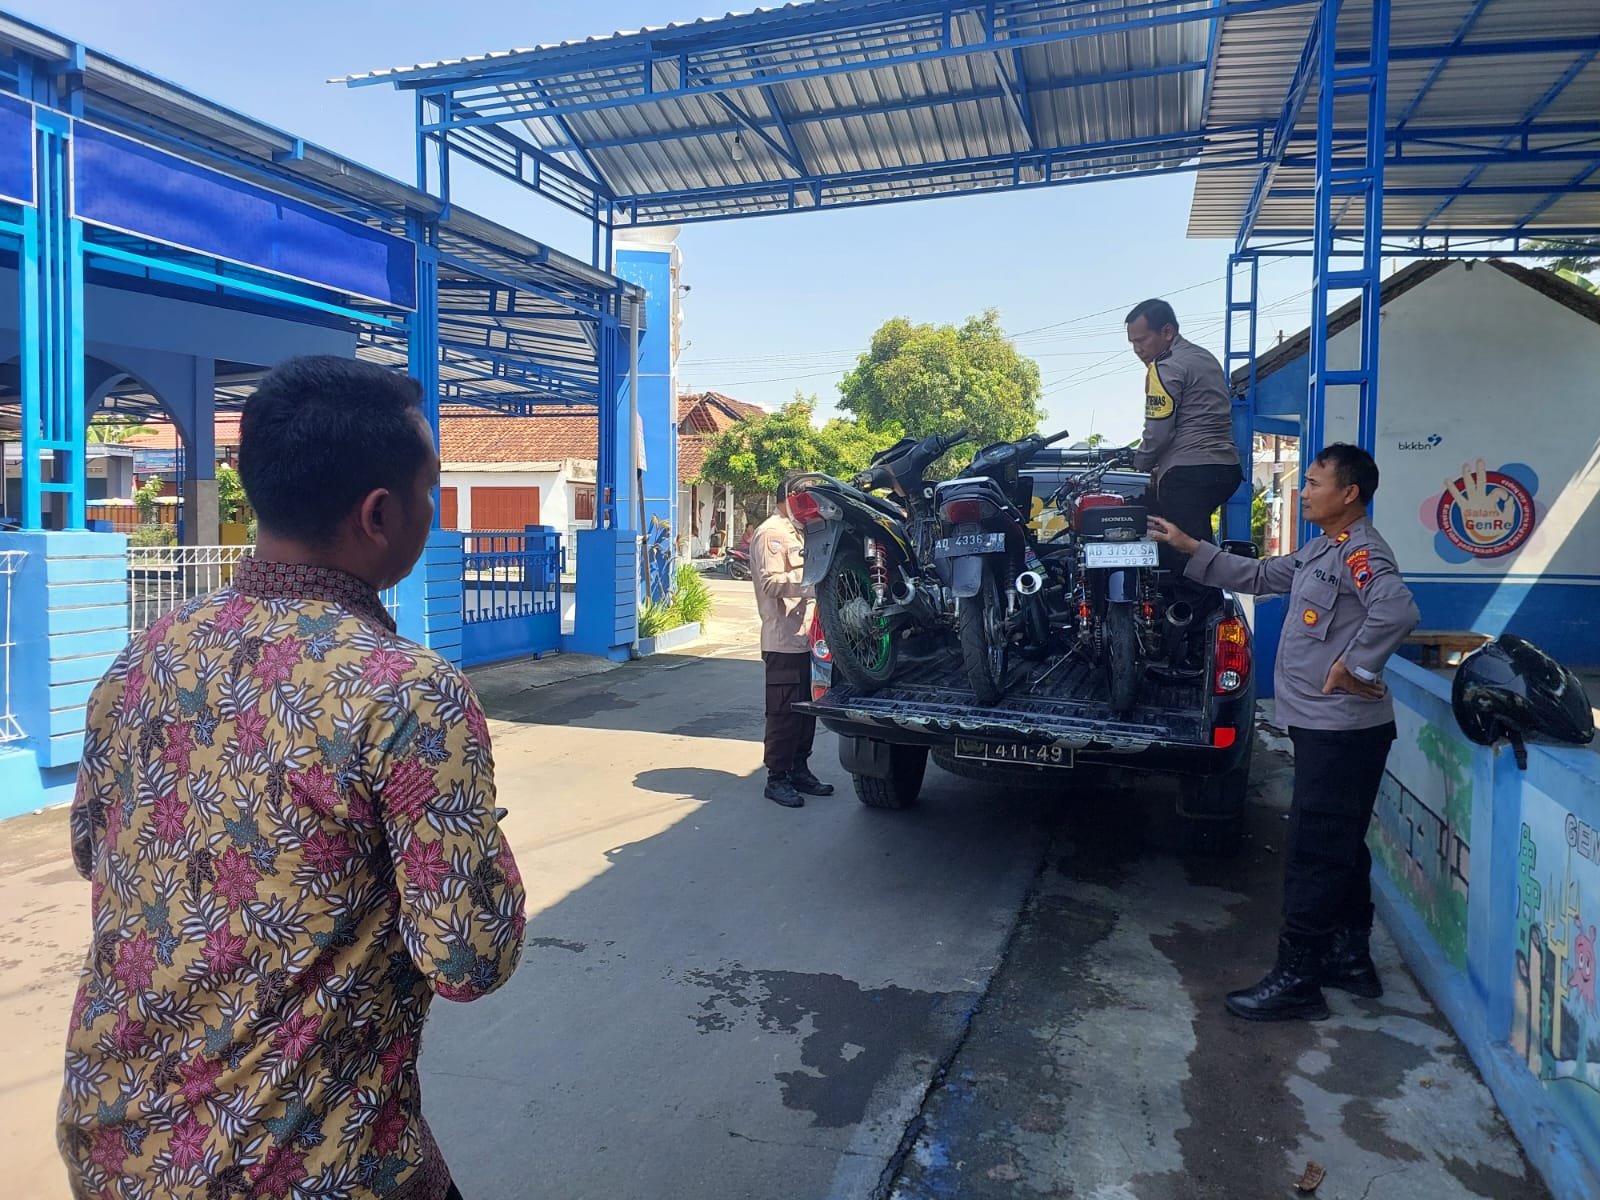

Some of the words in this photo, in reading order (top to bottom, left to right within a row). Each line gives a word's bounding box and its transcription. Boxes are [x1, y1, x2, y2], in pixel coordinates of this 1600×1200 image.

[1398, 441, 1432, 450] bkkbn
[1464, 509, 1500, 517] Salam
[1465, 520, 1512, 530] GenRe
[955, 535, 984, 546] 4336
[1140, 544, 1155, 555] SA
